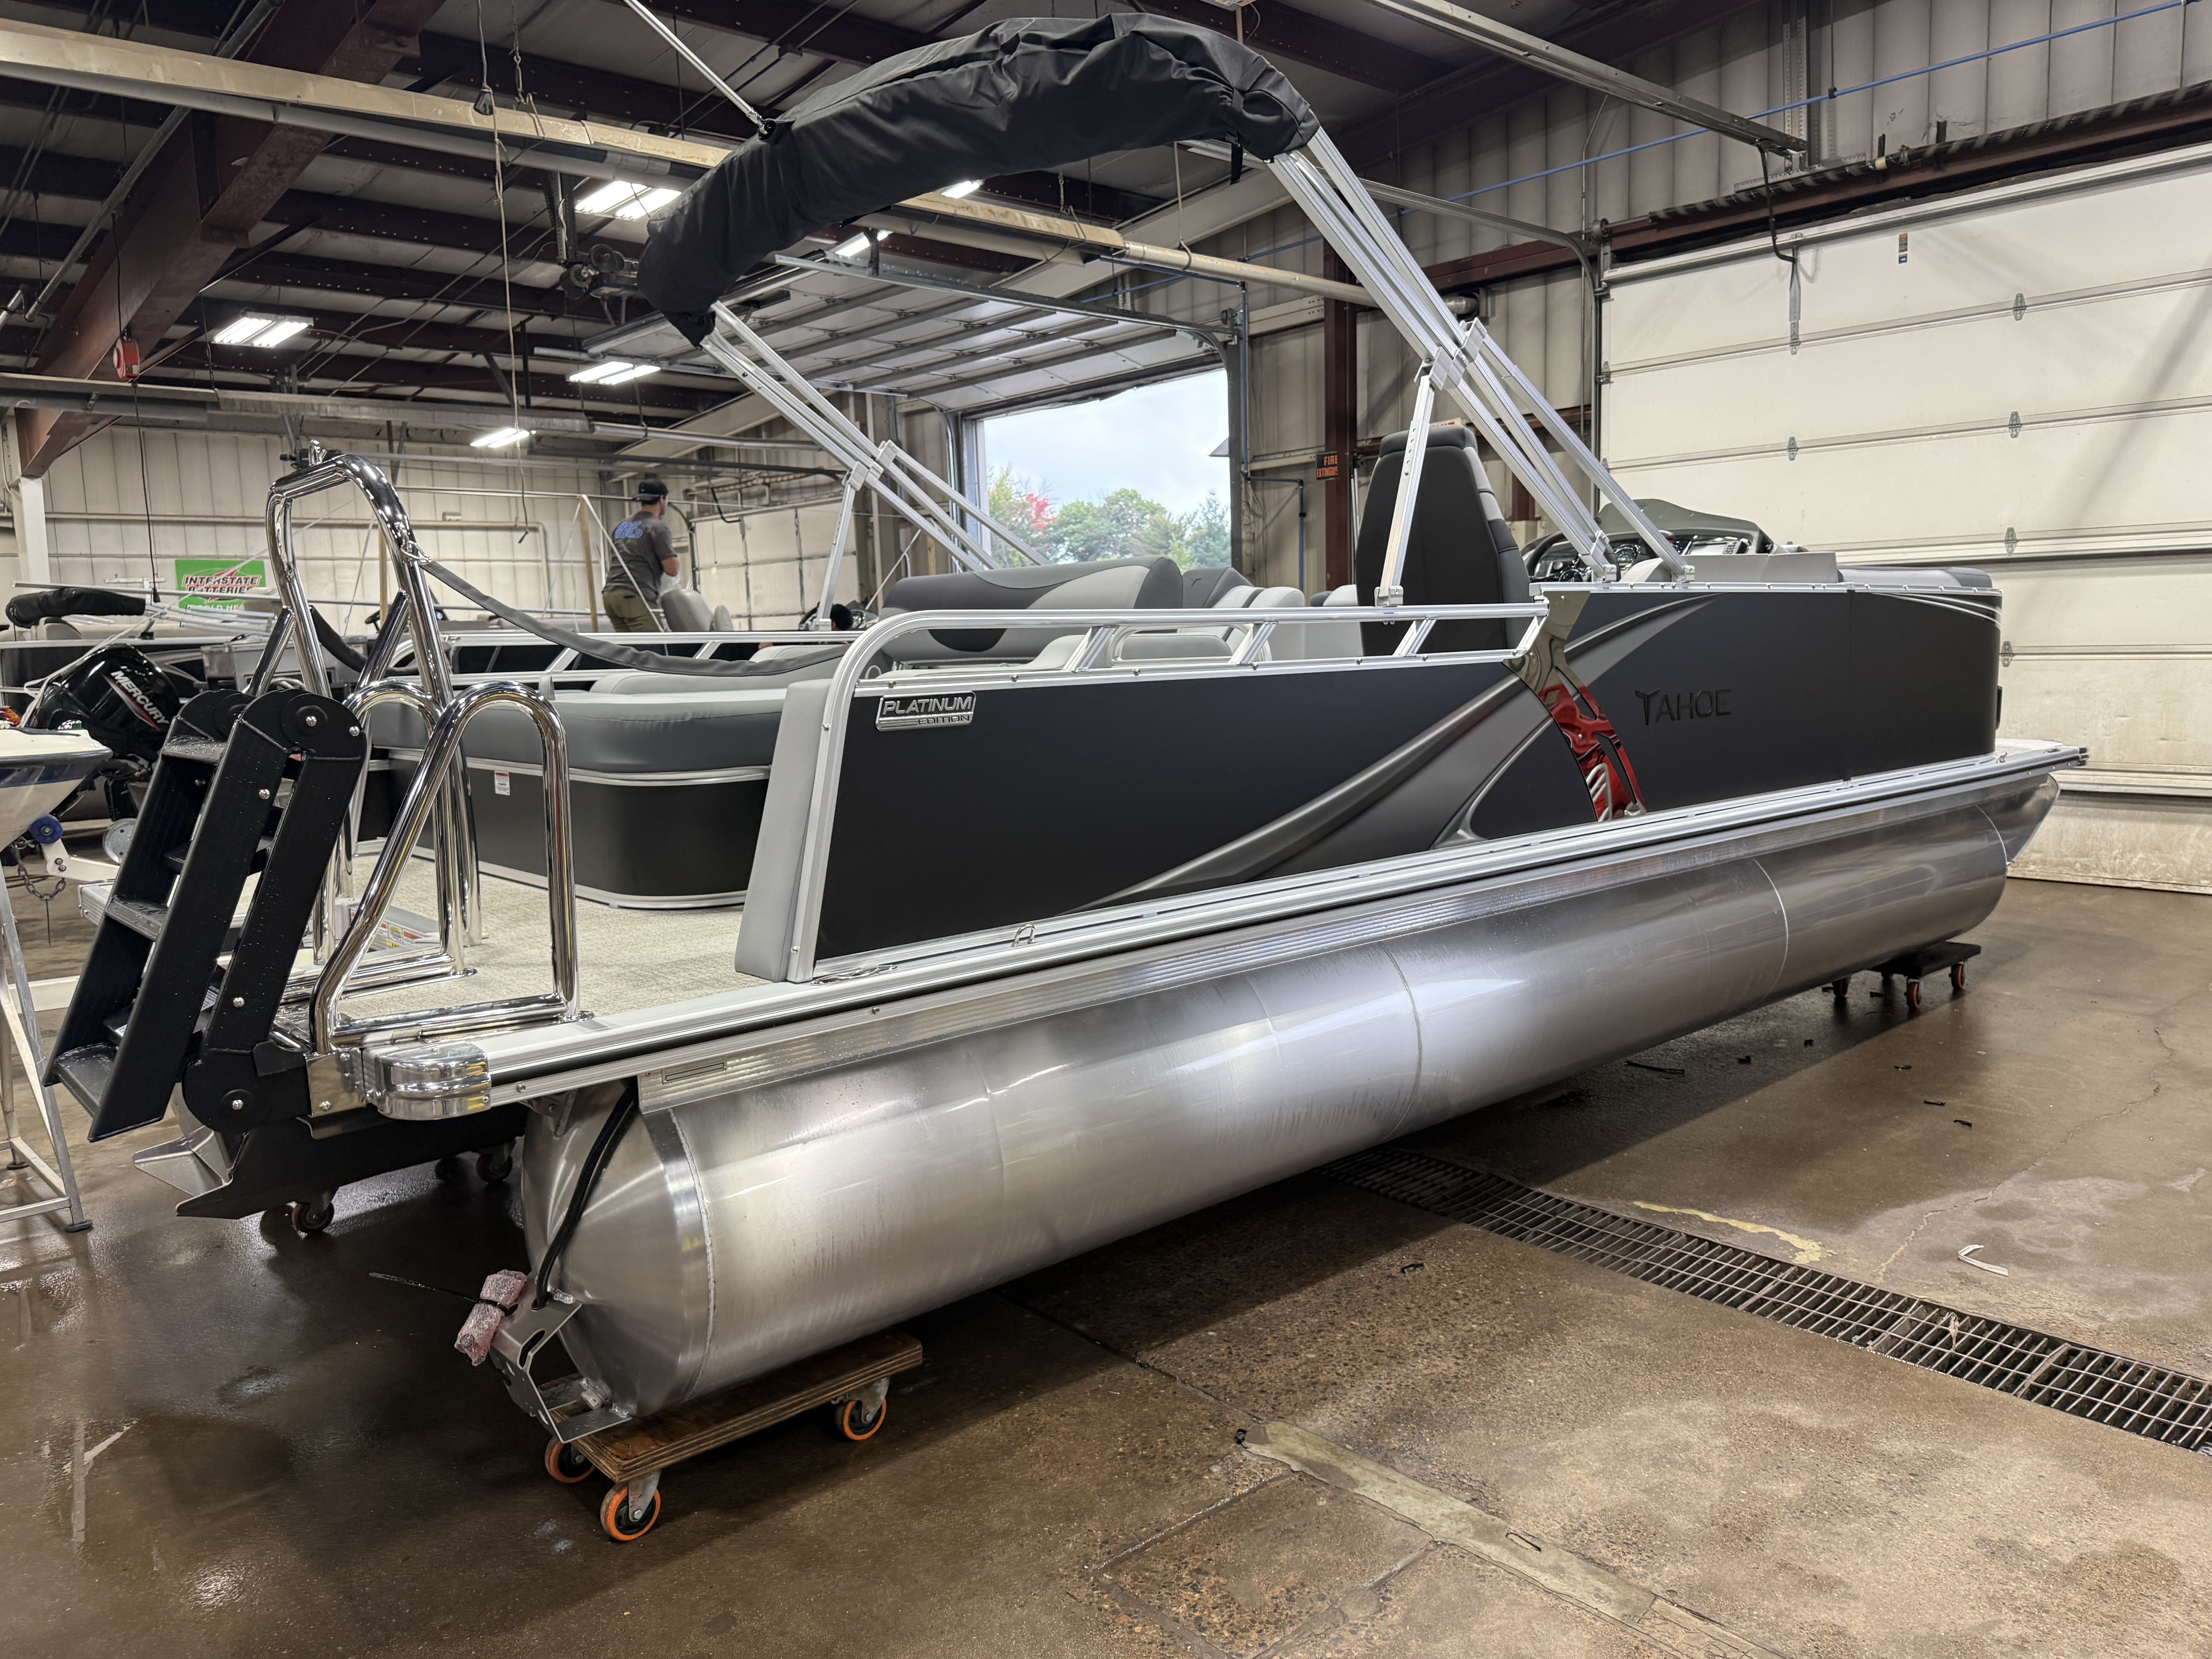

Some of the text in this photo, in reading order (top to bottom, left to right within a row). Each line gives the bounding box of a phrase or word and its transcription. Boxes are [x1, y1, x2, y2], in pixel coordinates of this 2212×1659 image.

[110, 670, 170, 724] MERCURY
[883, 696, 972, 715] PLATINUM
[1634, 687, 1732, 726] TAHOE
[918, 715, 970, 725] EDITION
